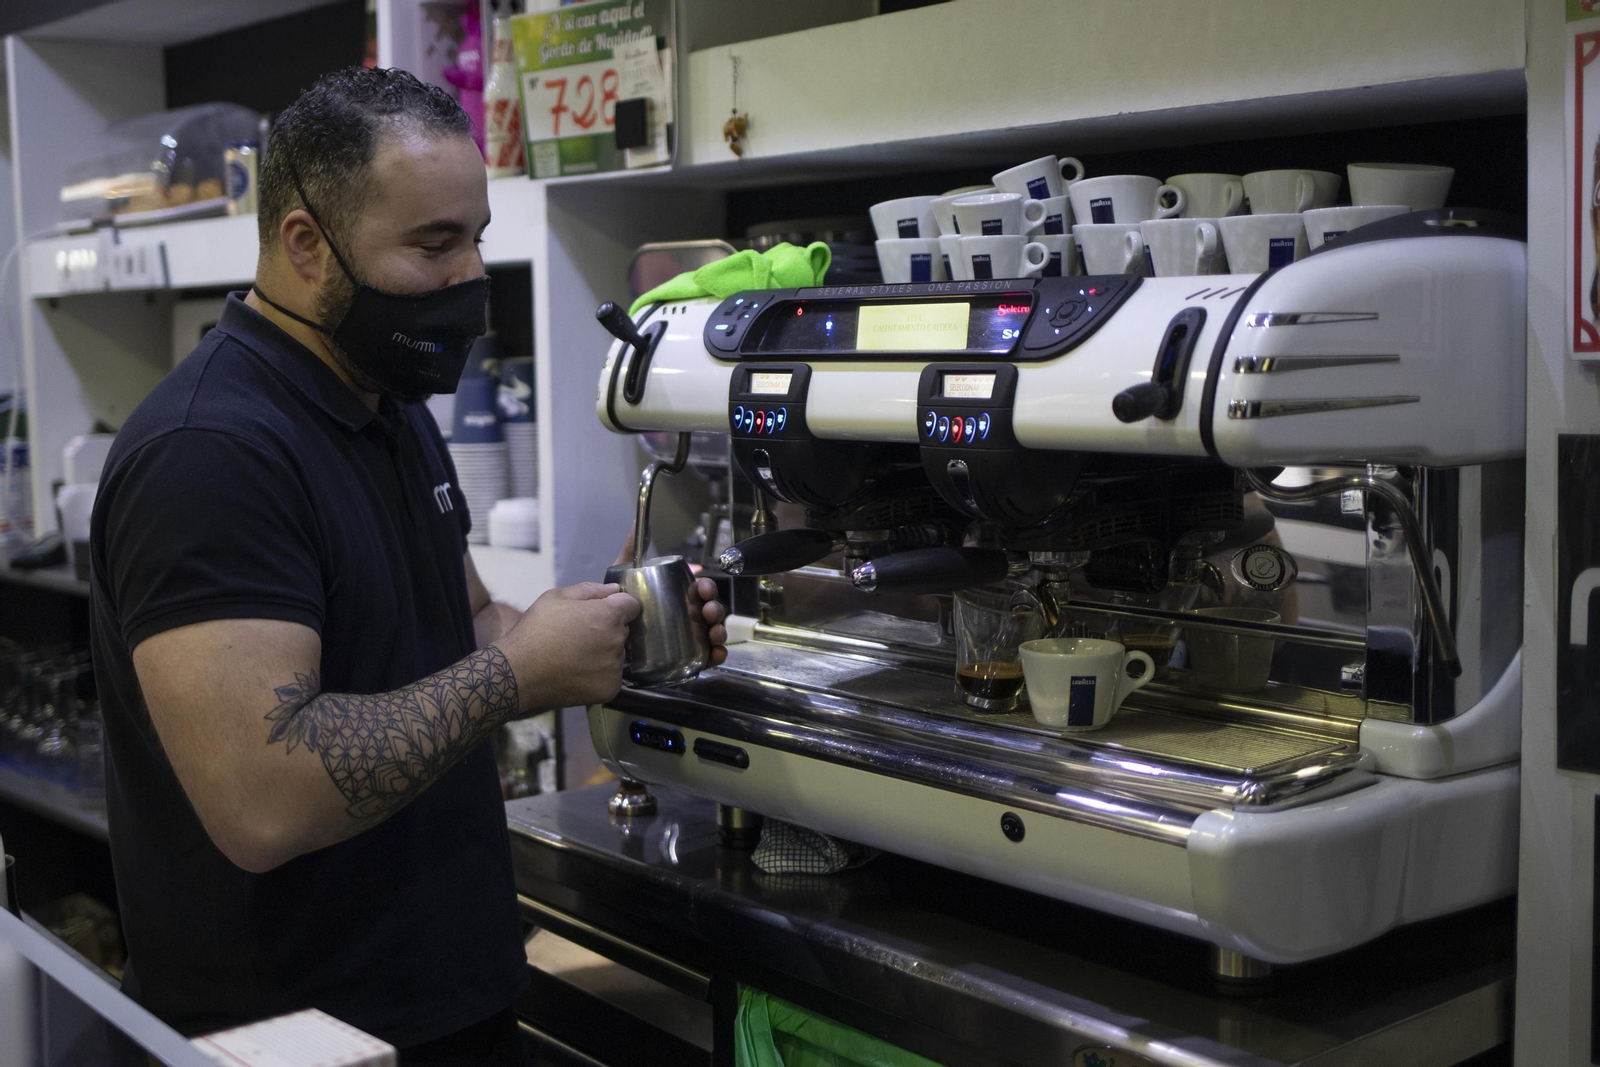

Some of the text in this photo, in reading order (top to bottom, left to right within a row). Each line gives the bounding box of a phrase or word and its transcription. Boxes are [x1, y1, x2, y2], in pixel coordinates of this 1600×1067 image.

[579, 37, 592, 54] de
[817, 285, 866, 297] SEVERAL
[927, 282, 952, 293] ONE
[957, 279, 1013, 291] PASSION
